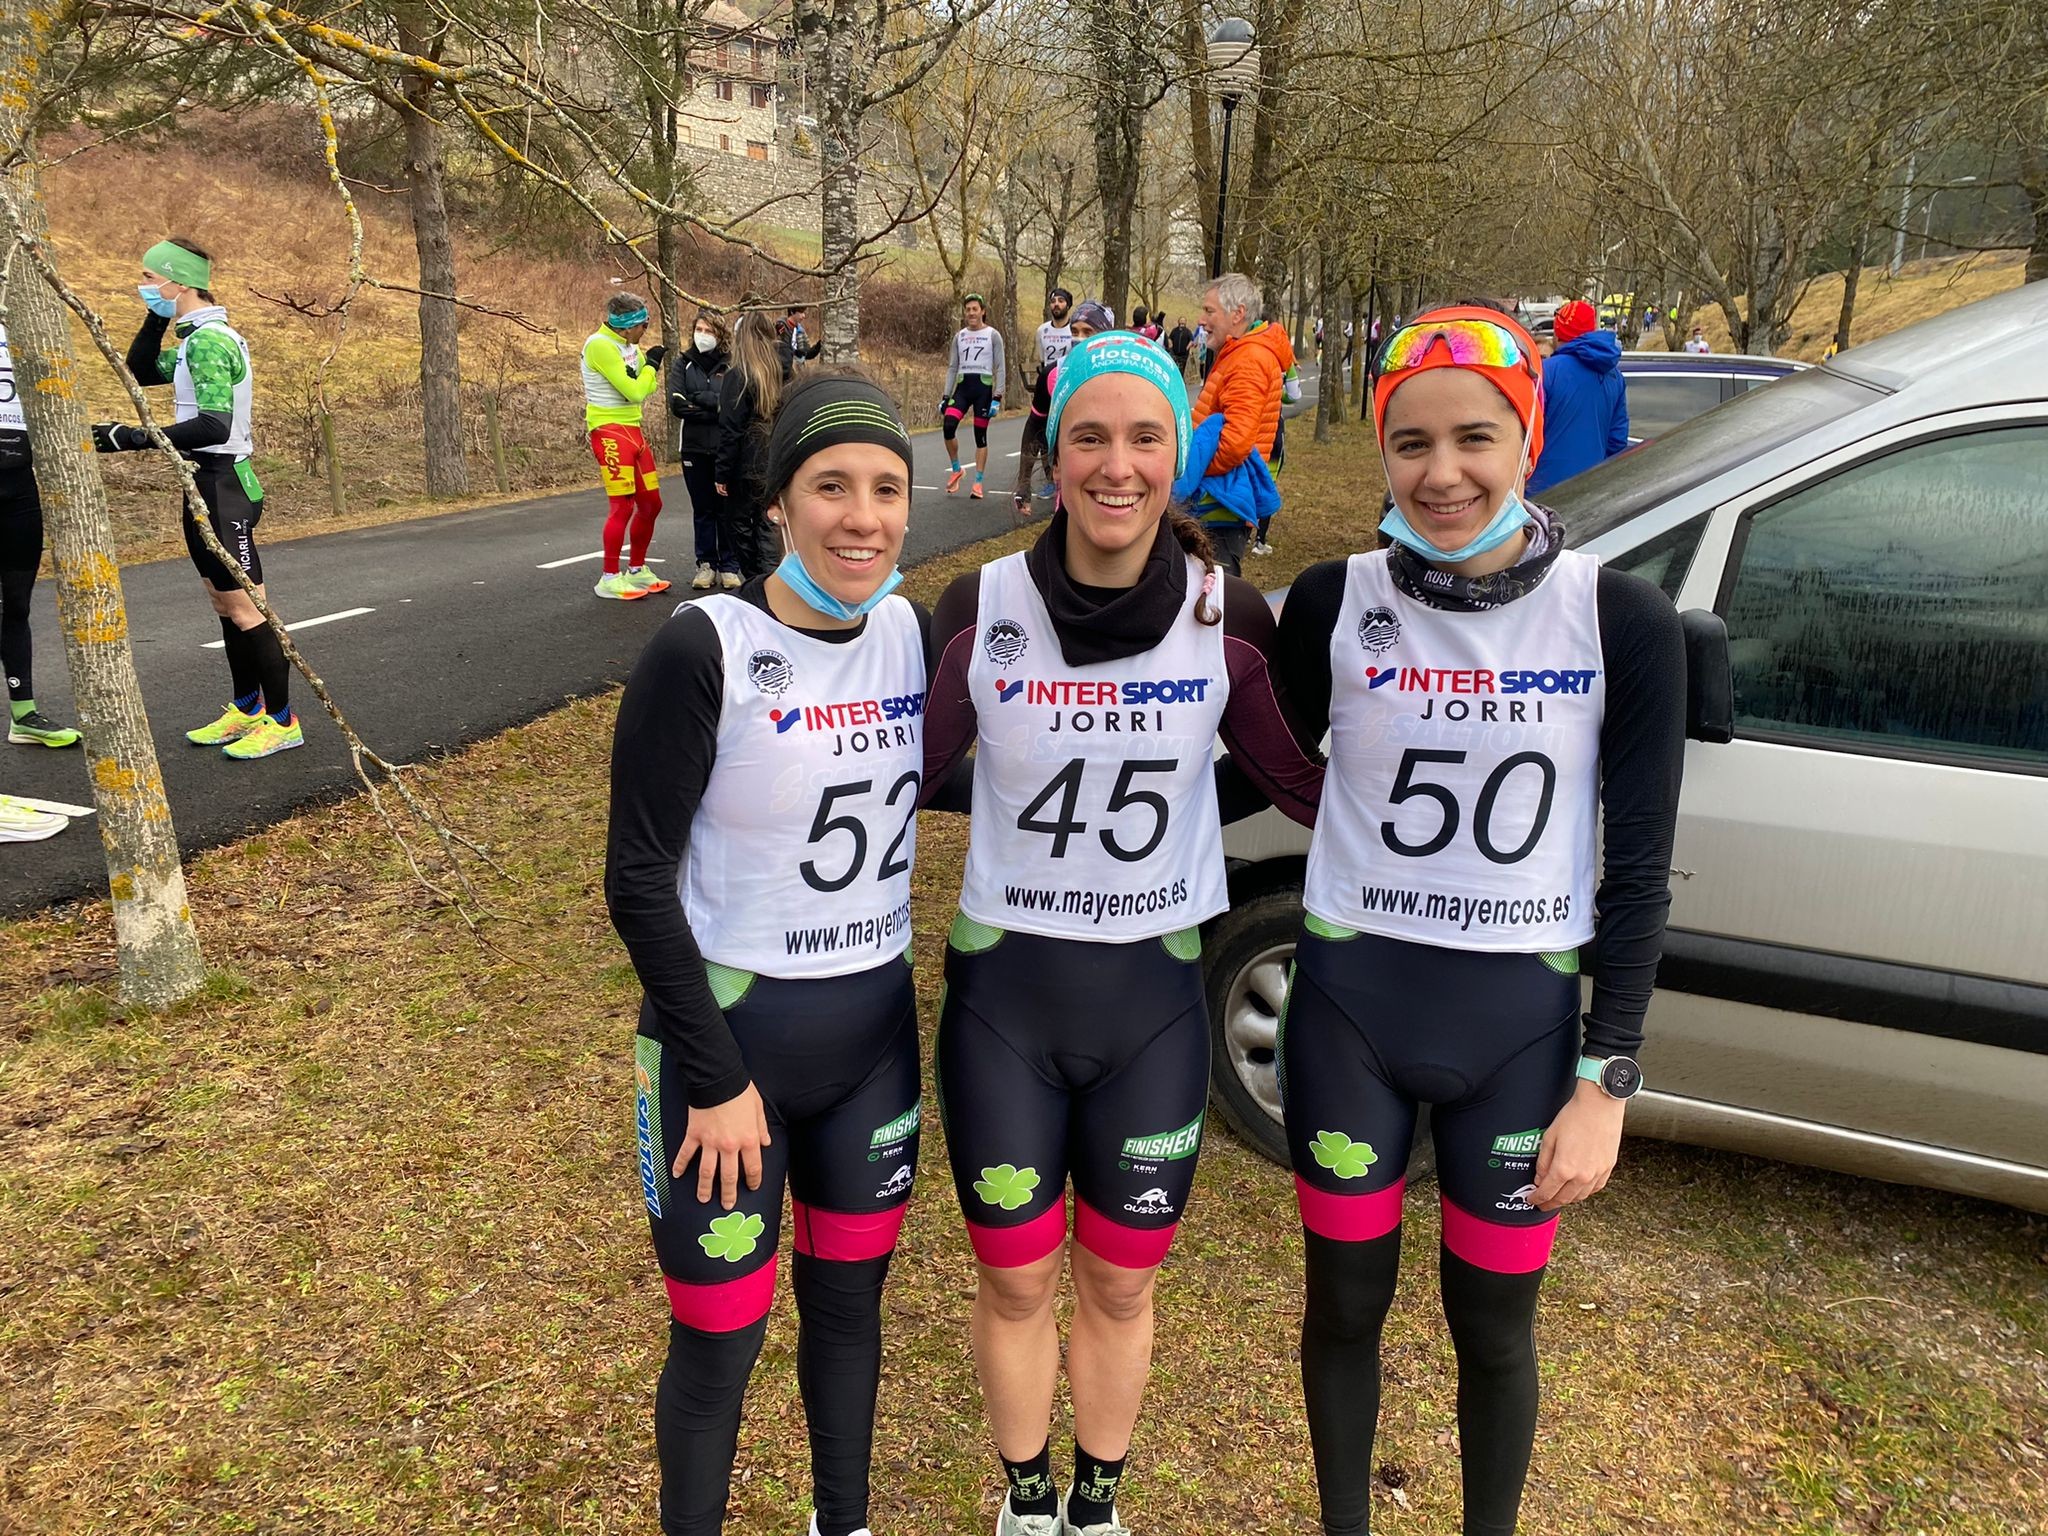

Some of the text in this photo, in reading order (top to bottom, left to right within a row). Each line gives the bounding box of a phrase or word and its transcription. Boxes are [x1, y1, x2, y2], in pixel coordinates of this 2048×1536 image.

[963, 346, 985, 361] 17
[1046, 345, 1067, 361] 21
[1091, 348, 1170, 384] Hotansa
[1092, 358, 1139, 370] ANDORRA
[1049, 711, 1163, 732] JORRI
[1420, 699, 1544, 722] JORRI
[832, 723, 915, 756] JORRI
[1017, 758, 1179, 863] 45
[1380, 748, 1557, 865] 50
[799, 770, 921, 893] 52
[1005, 877, 1188, 925] www.mayencos.es
[1362, 886, 1571, 931] www.mayencos.es
[873, 1103, 920, 1143] FINISHE
[1125, 1121, 1199, 1156] FINISHER
[637, 1088, 663, 1220] SALTOKI
[1133, 1163, 1158, 1173] KERN
[1504, 1161, 1530, 1169] KERN
[1080, 1480, 1104, 1499] GR
